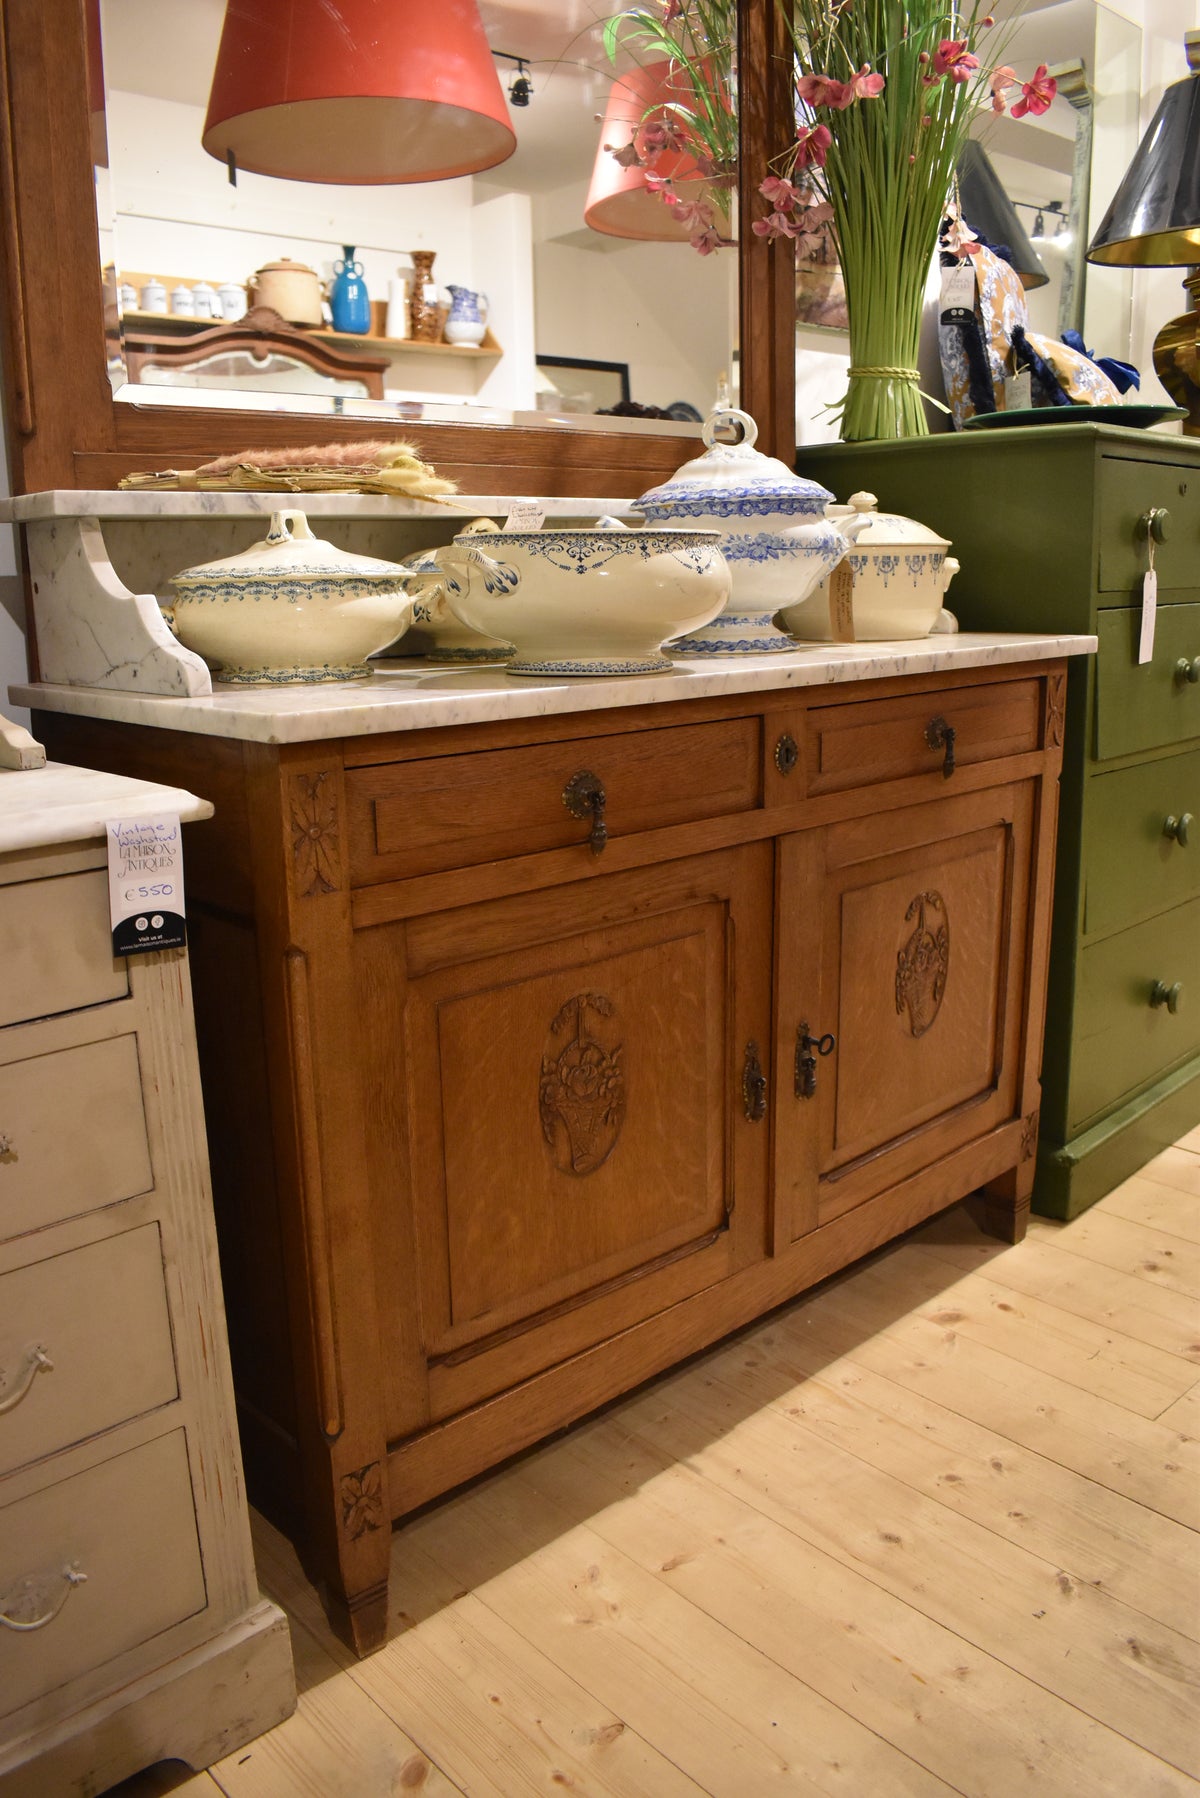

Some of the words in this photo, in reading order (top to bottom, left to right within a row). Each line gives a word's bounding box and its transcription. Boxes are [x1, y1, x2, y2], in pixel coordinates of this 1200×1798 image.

[112, 824, 165, 839] Vintage
[133, 843, 176, 858] MAISON
[117, 856, 174, 878] ANTIQUES
